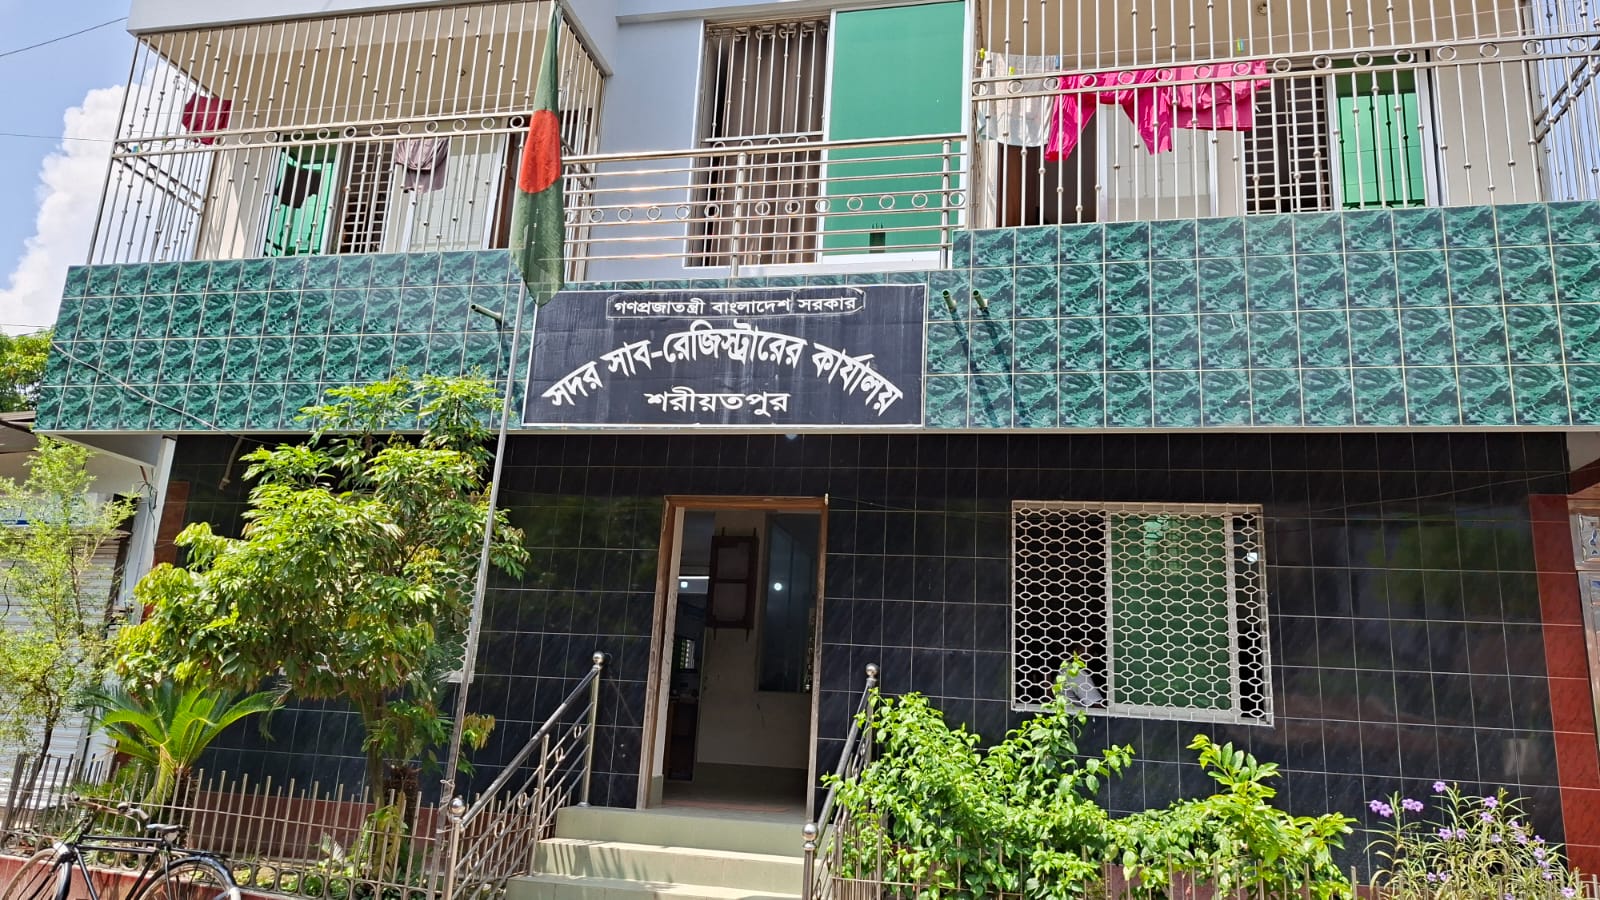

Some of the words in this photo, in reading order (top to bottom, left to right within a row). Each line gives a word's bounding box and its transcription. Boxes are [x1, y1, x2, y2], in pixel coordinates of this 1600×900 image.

[614, 297, 705, 315] গণপ্রজাতন্ত্রী
[711, 298, 790, 315] বাংলাদেশ
[797, 296, 857, 312] সরকার
[541, 361, 603, 407] সদর
[601, 319, 807, 376] সাব-রেজিস্ট্রারের
[812, 342, 903, 416] কার্যালয়
[645, 386, 791, 417] শরীয়তপুর
